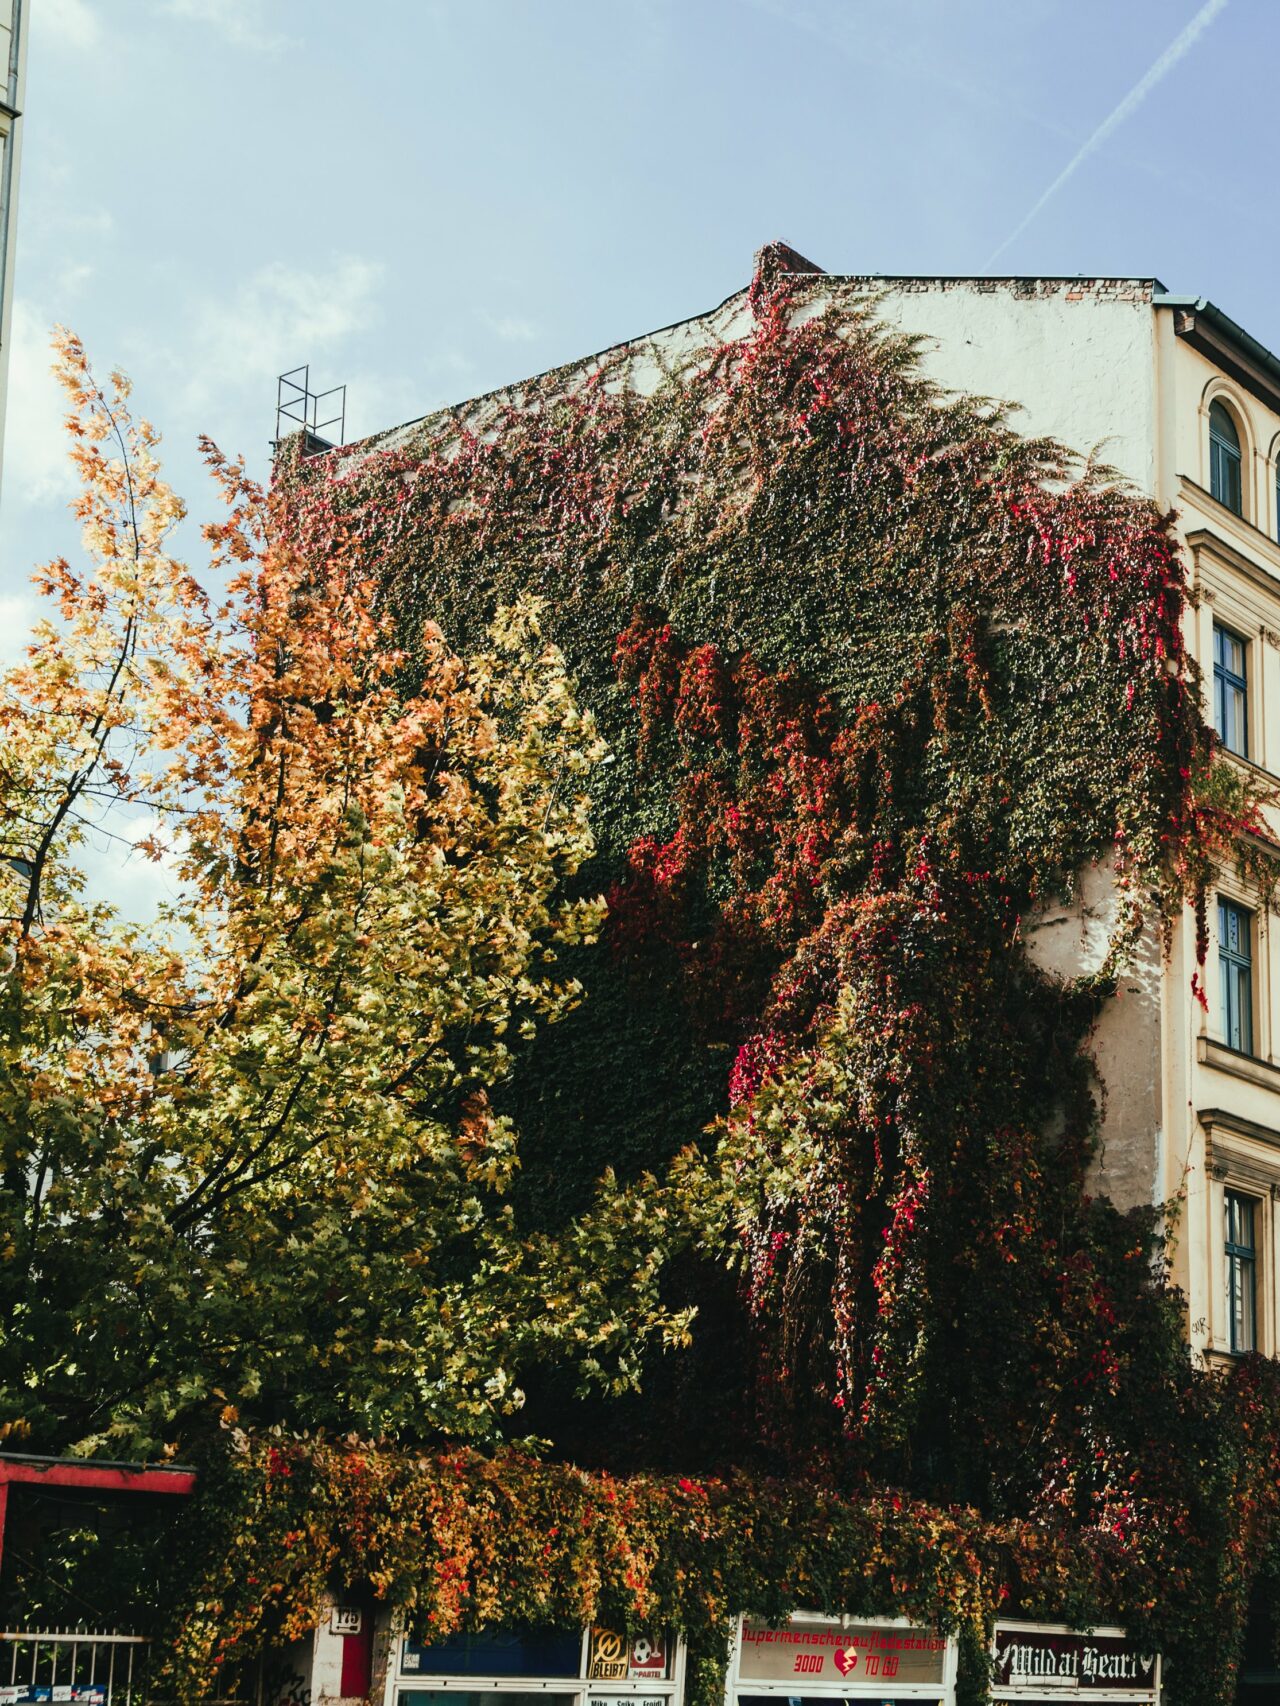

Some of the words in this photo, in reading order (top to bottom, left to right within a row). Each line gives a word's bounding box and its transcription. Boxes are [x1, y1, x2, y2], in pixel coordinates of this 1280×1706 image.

[337, 1610, 359, 1624] 175
[794, 1655, 825, 1673] 3000
[865, 1655, 880, 1675] TO
[882, 1656, 899, 1677] GO
[1011, 1644, 1057, 1676] Wild
[1059, 1649, 1080, 1676] at
[593, 1663, 626, 1677] BLEIBT
